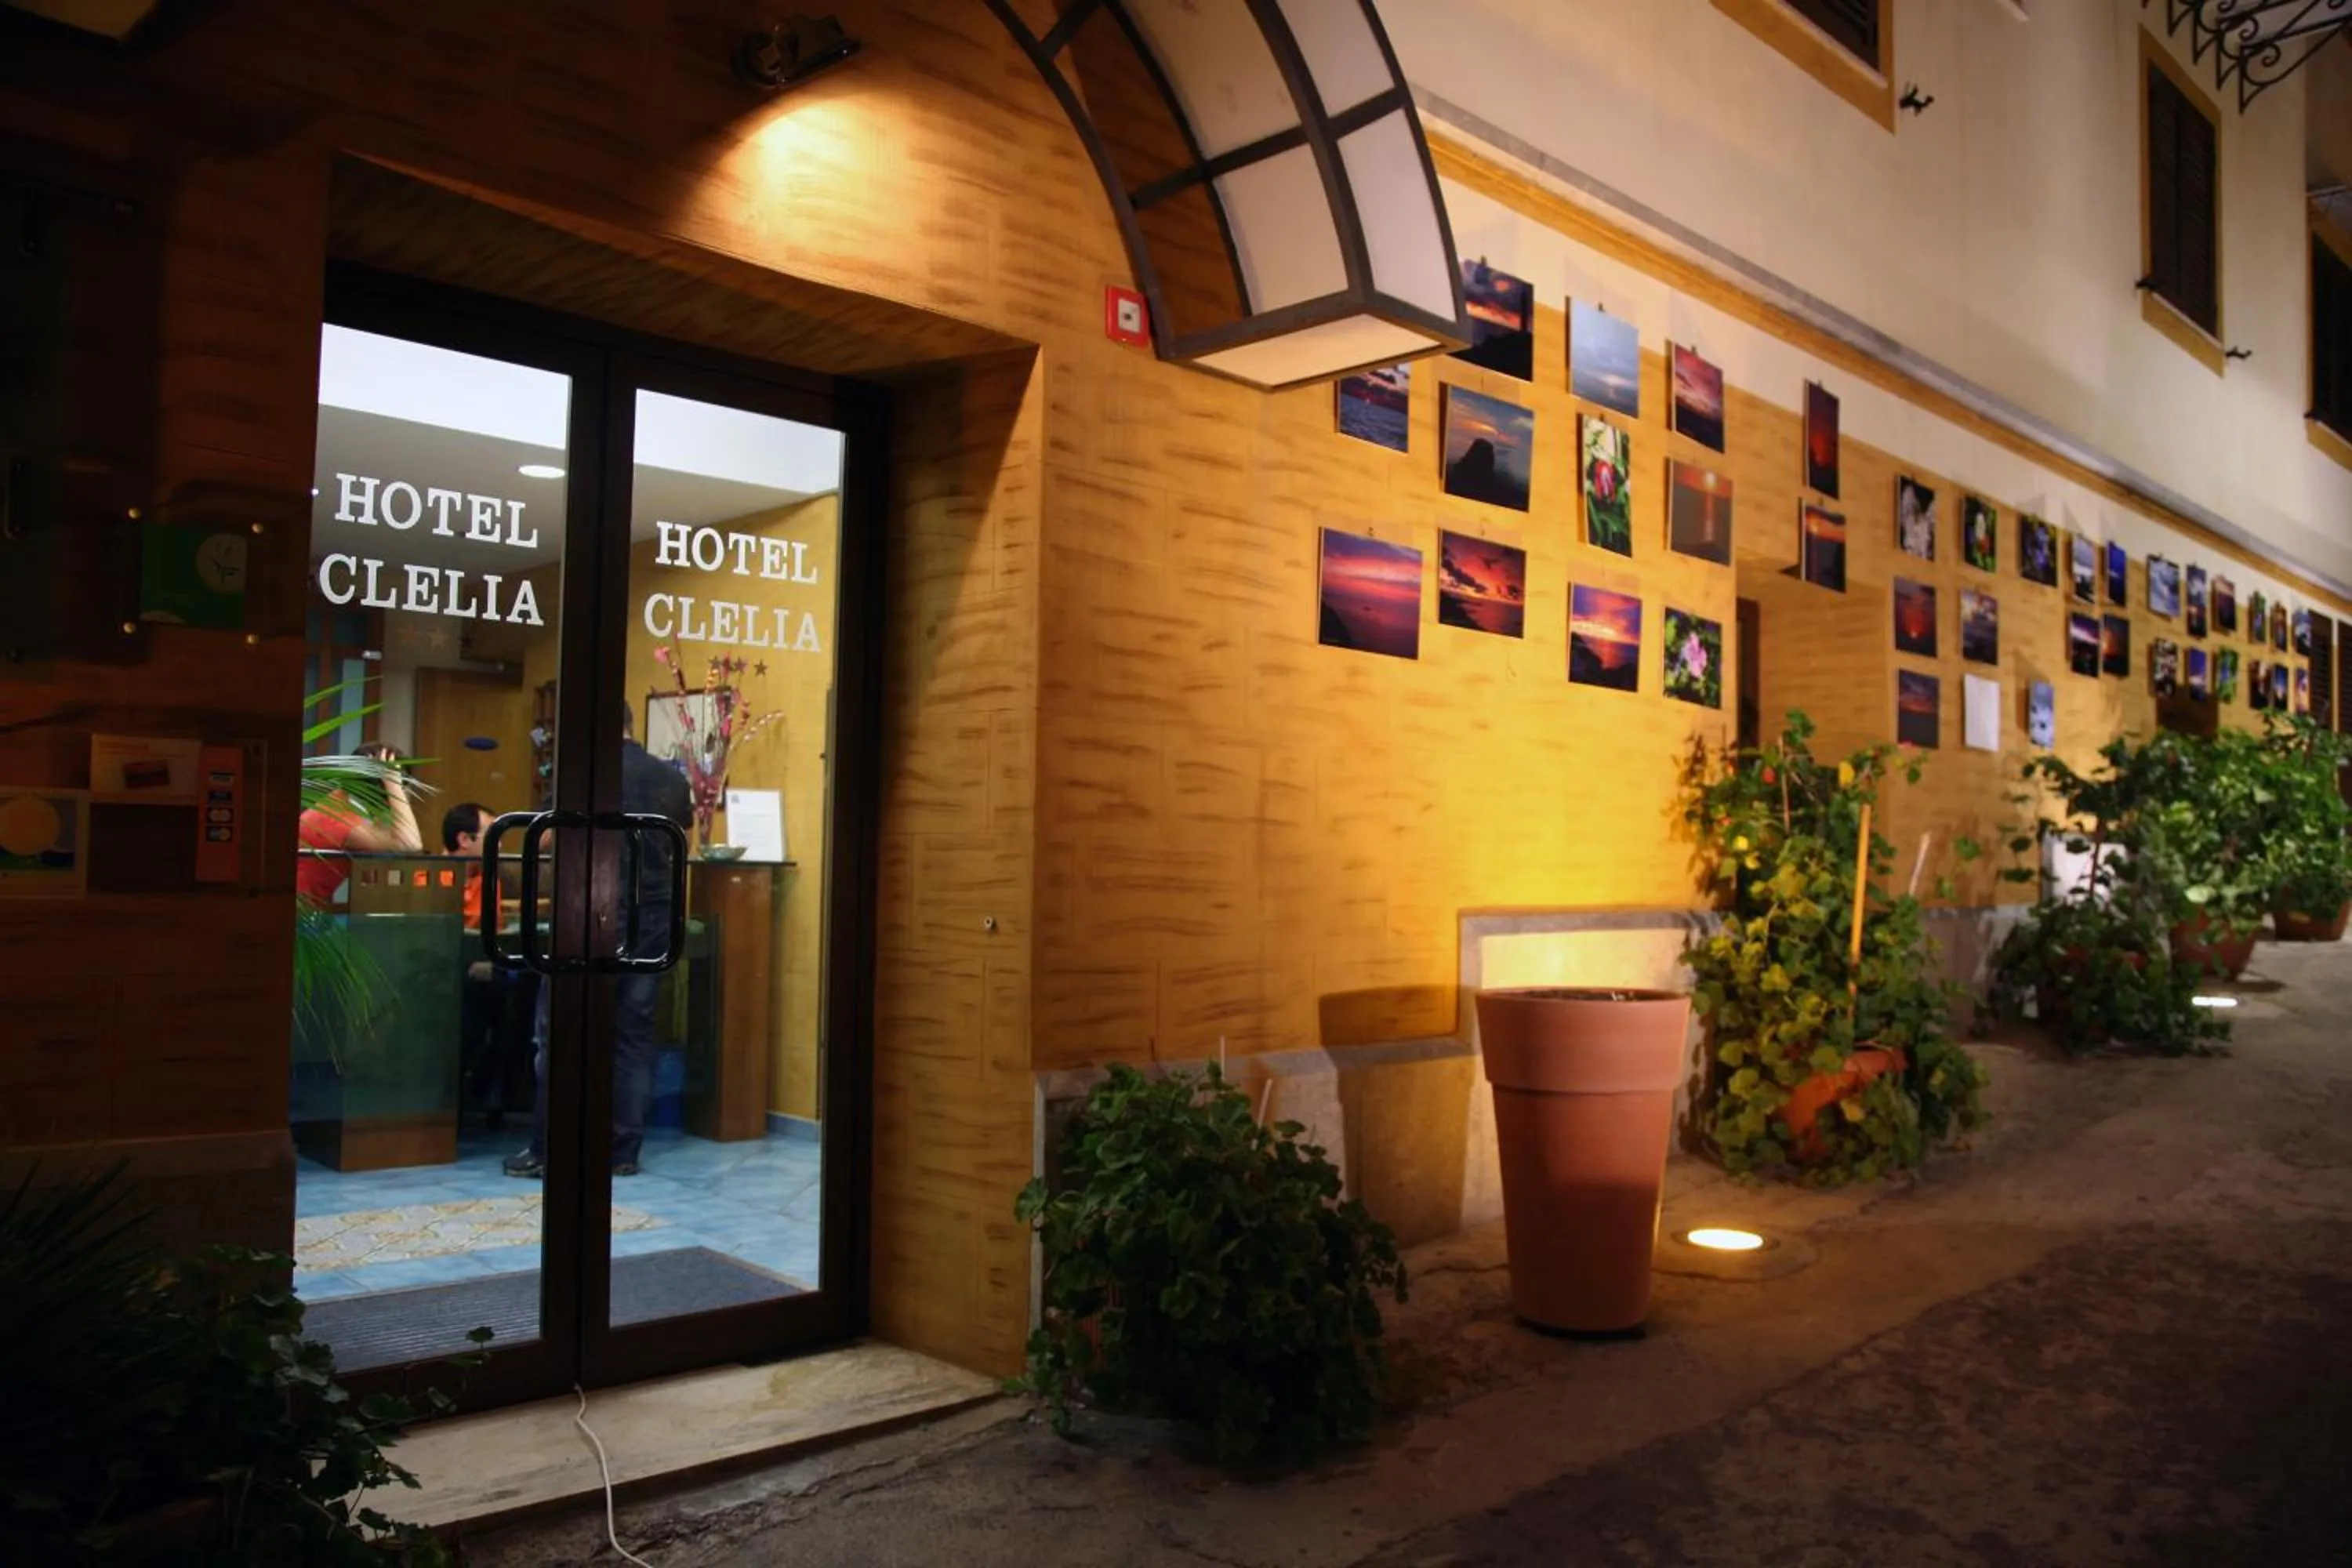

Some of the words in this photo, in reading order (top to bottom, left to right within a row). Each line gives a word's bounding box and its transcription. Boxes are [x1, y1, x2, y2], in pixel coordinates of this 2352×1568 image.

[336, 474, 538, 547] HOTEL
[655, 521, 818, 584] HOTEL
[319, 554, 544, 626] CLELIA
[644, 593, 820, 653] CLELIA
